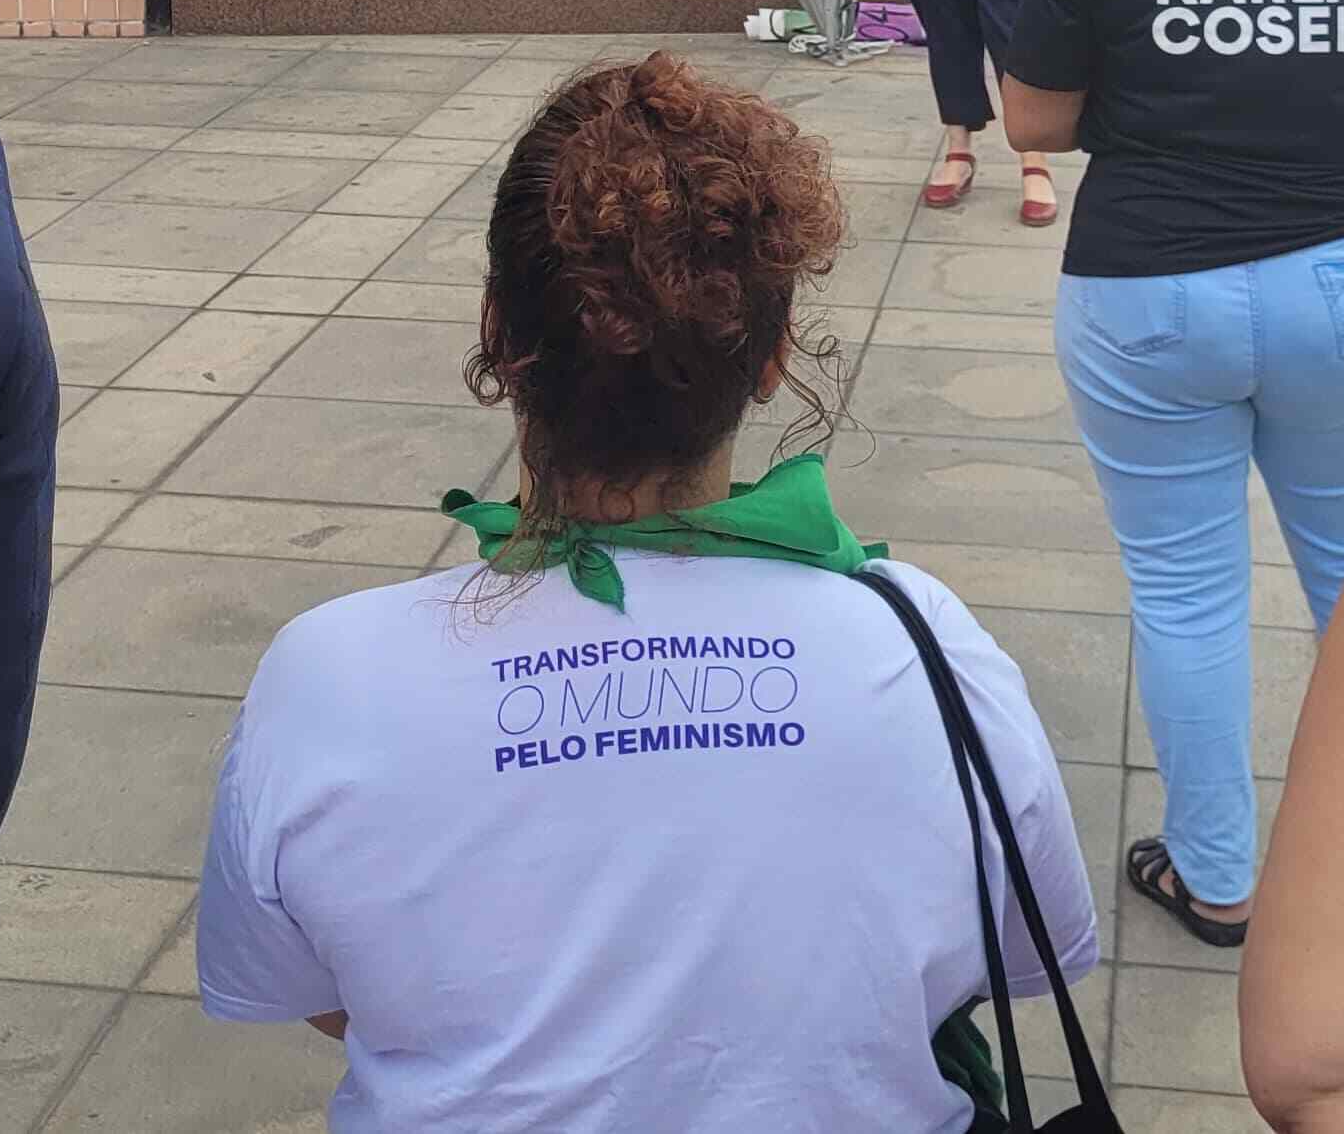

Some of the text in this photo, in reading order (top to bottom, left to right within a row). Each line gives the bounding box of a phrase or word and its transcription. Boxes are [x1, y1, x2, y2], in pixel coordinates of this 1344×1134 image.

[492, 636, 796, 683] TRANSFORMANDO
[497, 666, 798, 735] O MUNDO
[495, 722, 805, 773] PELO FEMINISMO
